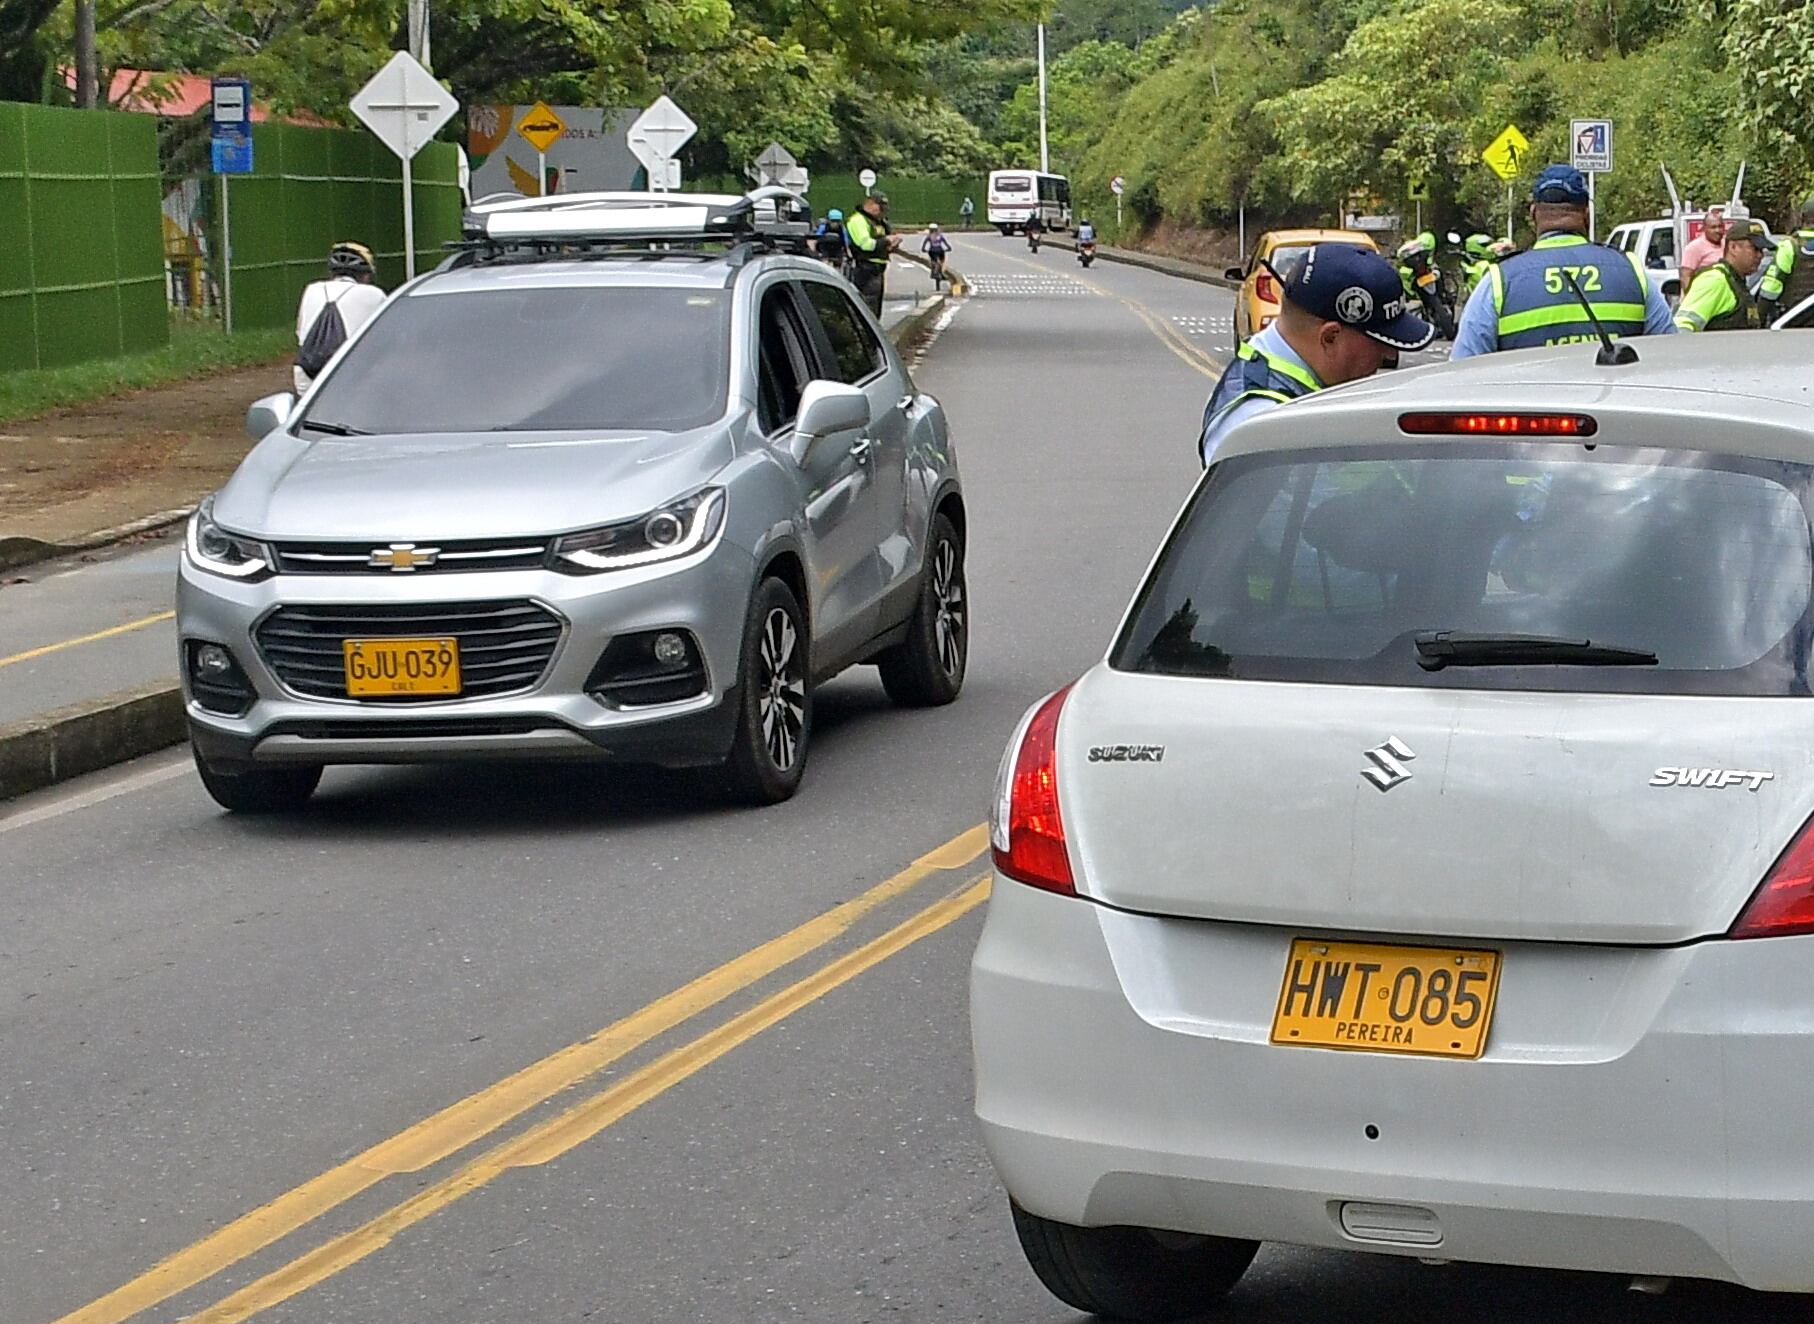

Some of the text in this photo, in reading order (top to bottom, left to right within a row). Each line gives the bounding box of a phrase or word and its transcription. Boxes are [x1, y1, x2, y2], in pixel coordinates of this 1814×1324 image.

[1545, 264, 1602, 294] 572
[350, 649, 453, 680] GJU 039
[1087, 744, 1167, 763] SUZUKI
[1648, 766, 1775, 793] SWIFT
[1283, 959, 1488, 1029] HWT 085
[1334, 1021, 1414, 1045] PEREIRA
